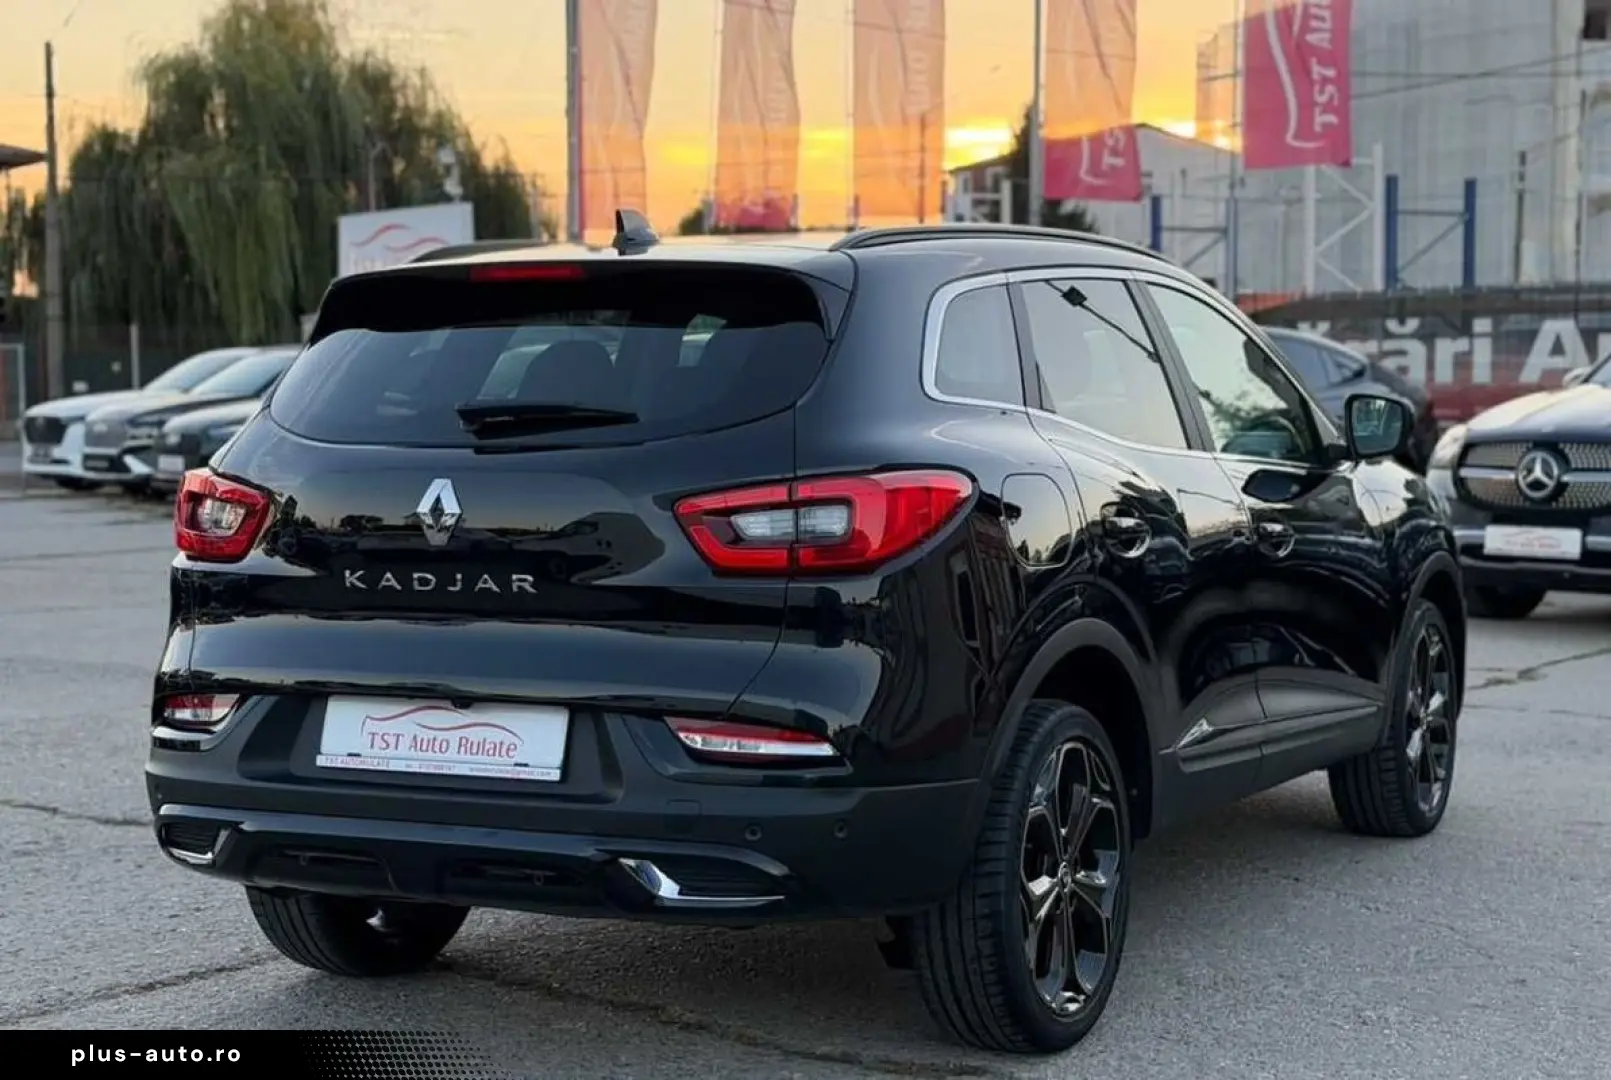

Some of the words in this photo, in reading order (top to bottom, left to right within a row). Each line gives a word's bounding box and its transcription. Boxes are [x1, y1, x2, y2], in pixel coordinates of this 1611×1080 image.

[1310, 57, 1339, 134] TST
[1101, 127, 1126, 171] TS
[1518, 318, 1611, 384] A
[344, 570, 538, 594] KADJAR
[367, 731, 404, 750] TST
[408, 733, 449, 754] Auto
[457, 737, 517, 759] Rulate
